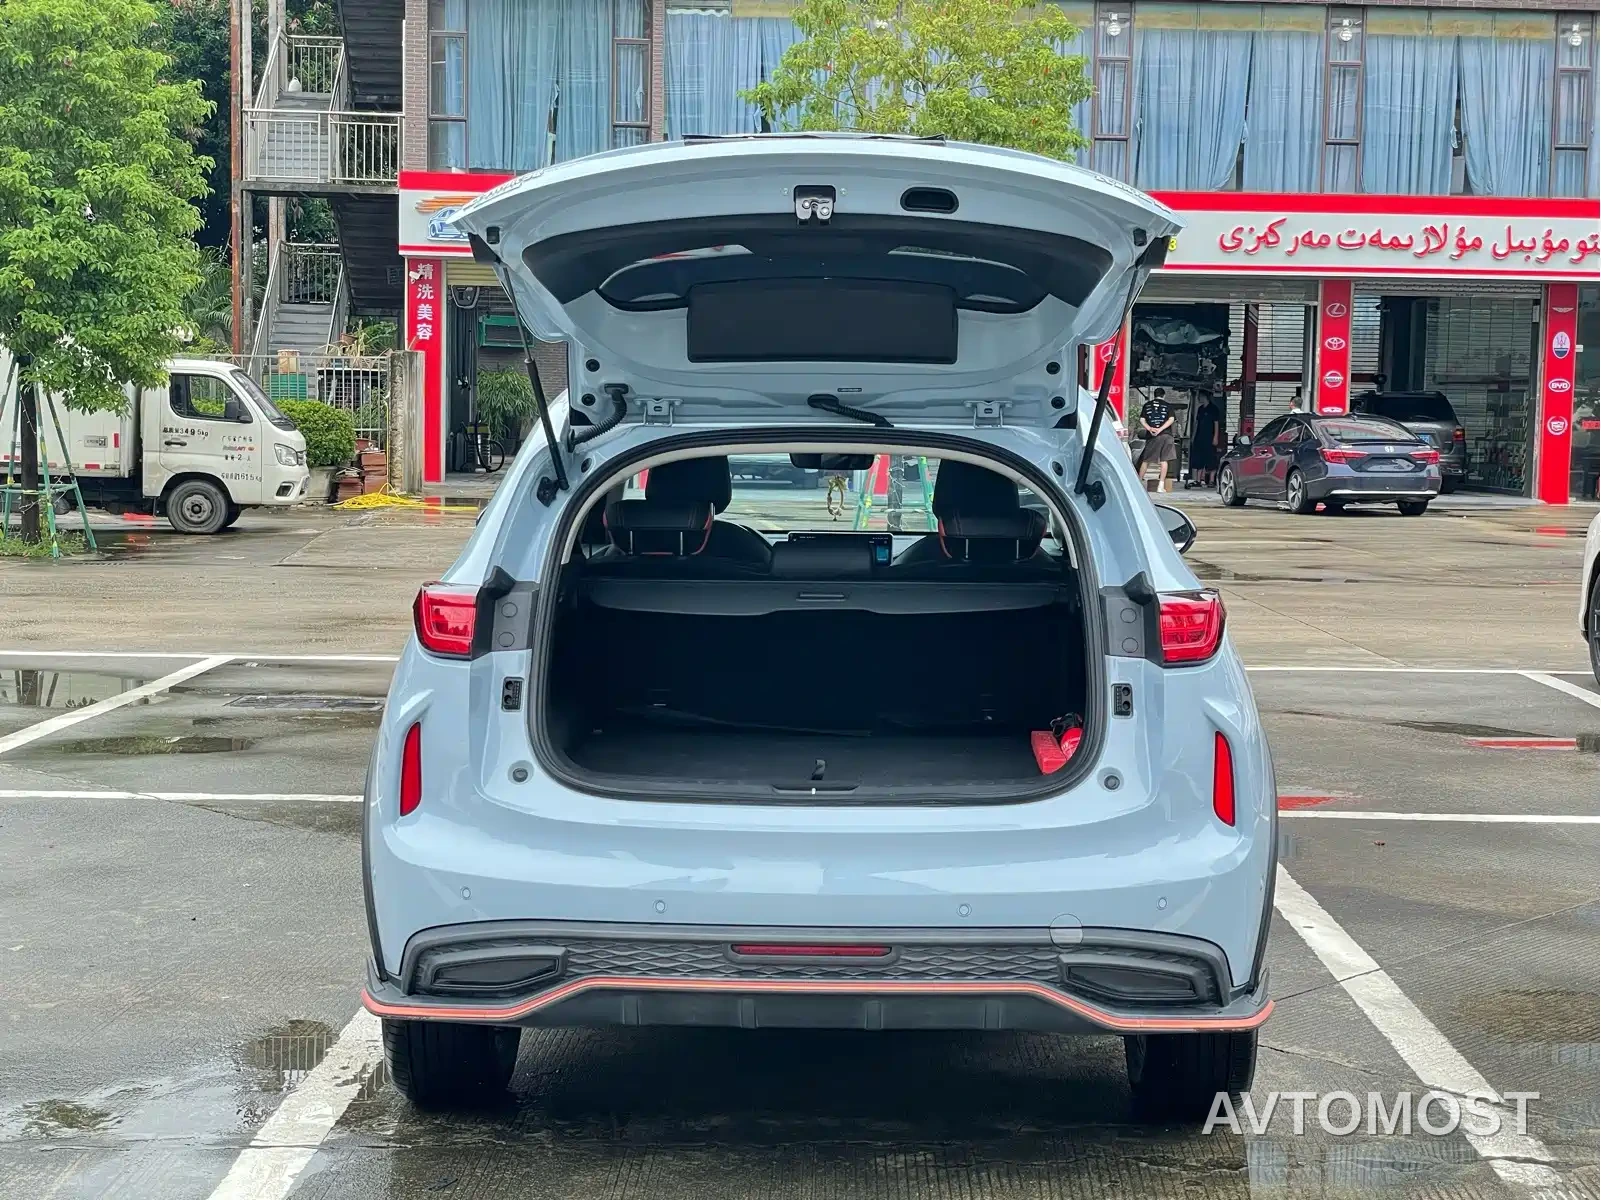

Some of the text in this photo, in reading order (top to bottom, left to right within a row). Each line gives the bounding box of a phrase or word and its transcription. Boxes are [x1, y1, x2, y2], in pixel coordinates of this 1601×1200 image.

[416, 263, 435, 340] 精洗美容
[1550, 381, 1569, 390] BYD
